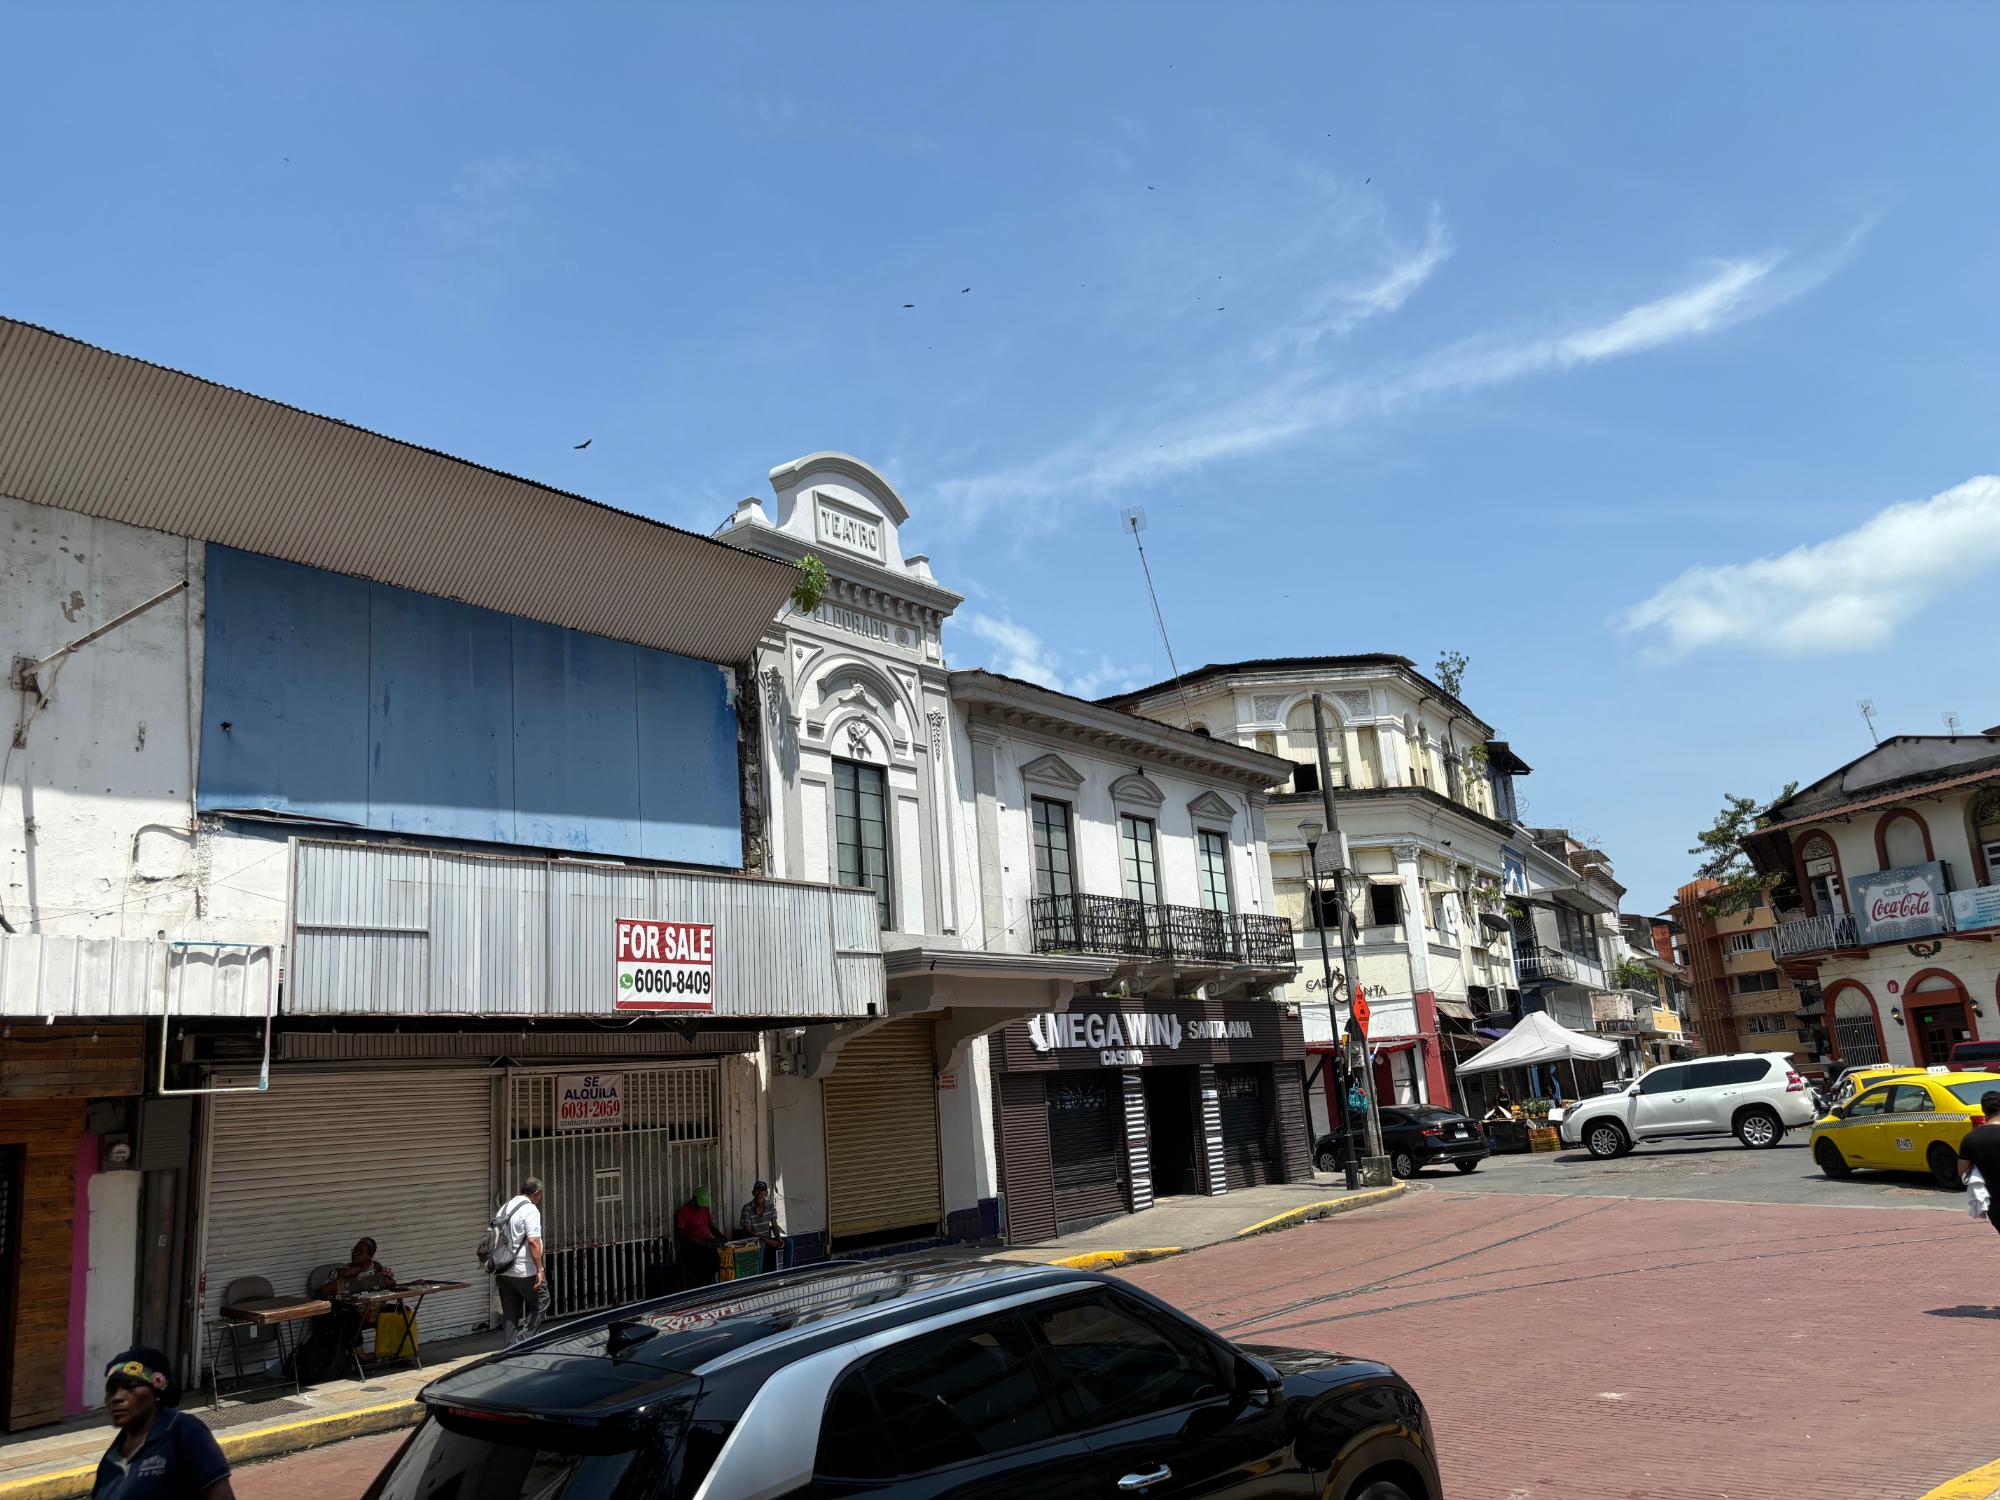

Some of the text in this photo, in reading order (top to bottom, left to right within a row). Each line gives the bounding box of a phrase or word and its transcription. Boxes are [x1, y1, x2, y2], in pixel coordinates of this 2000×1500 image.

[821, 509, 878, 552] TEATRO
[833, 606, 889, 642] DORADO
[619, 924, 712, 961] FOR SALE
[634, 968, 711, 995] 6060-8409
[1045, 1013, 1253, 1049] MEGA WIN SANTA ANA
[1101, 1050, 1144, 1066] CASINO
[564, 1088, 618, 1100] ALQUILA
[583, 1076, 600, 1087] SE
[561, 1099, 621, 1119] 6031-2059
